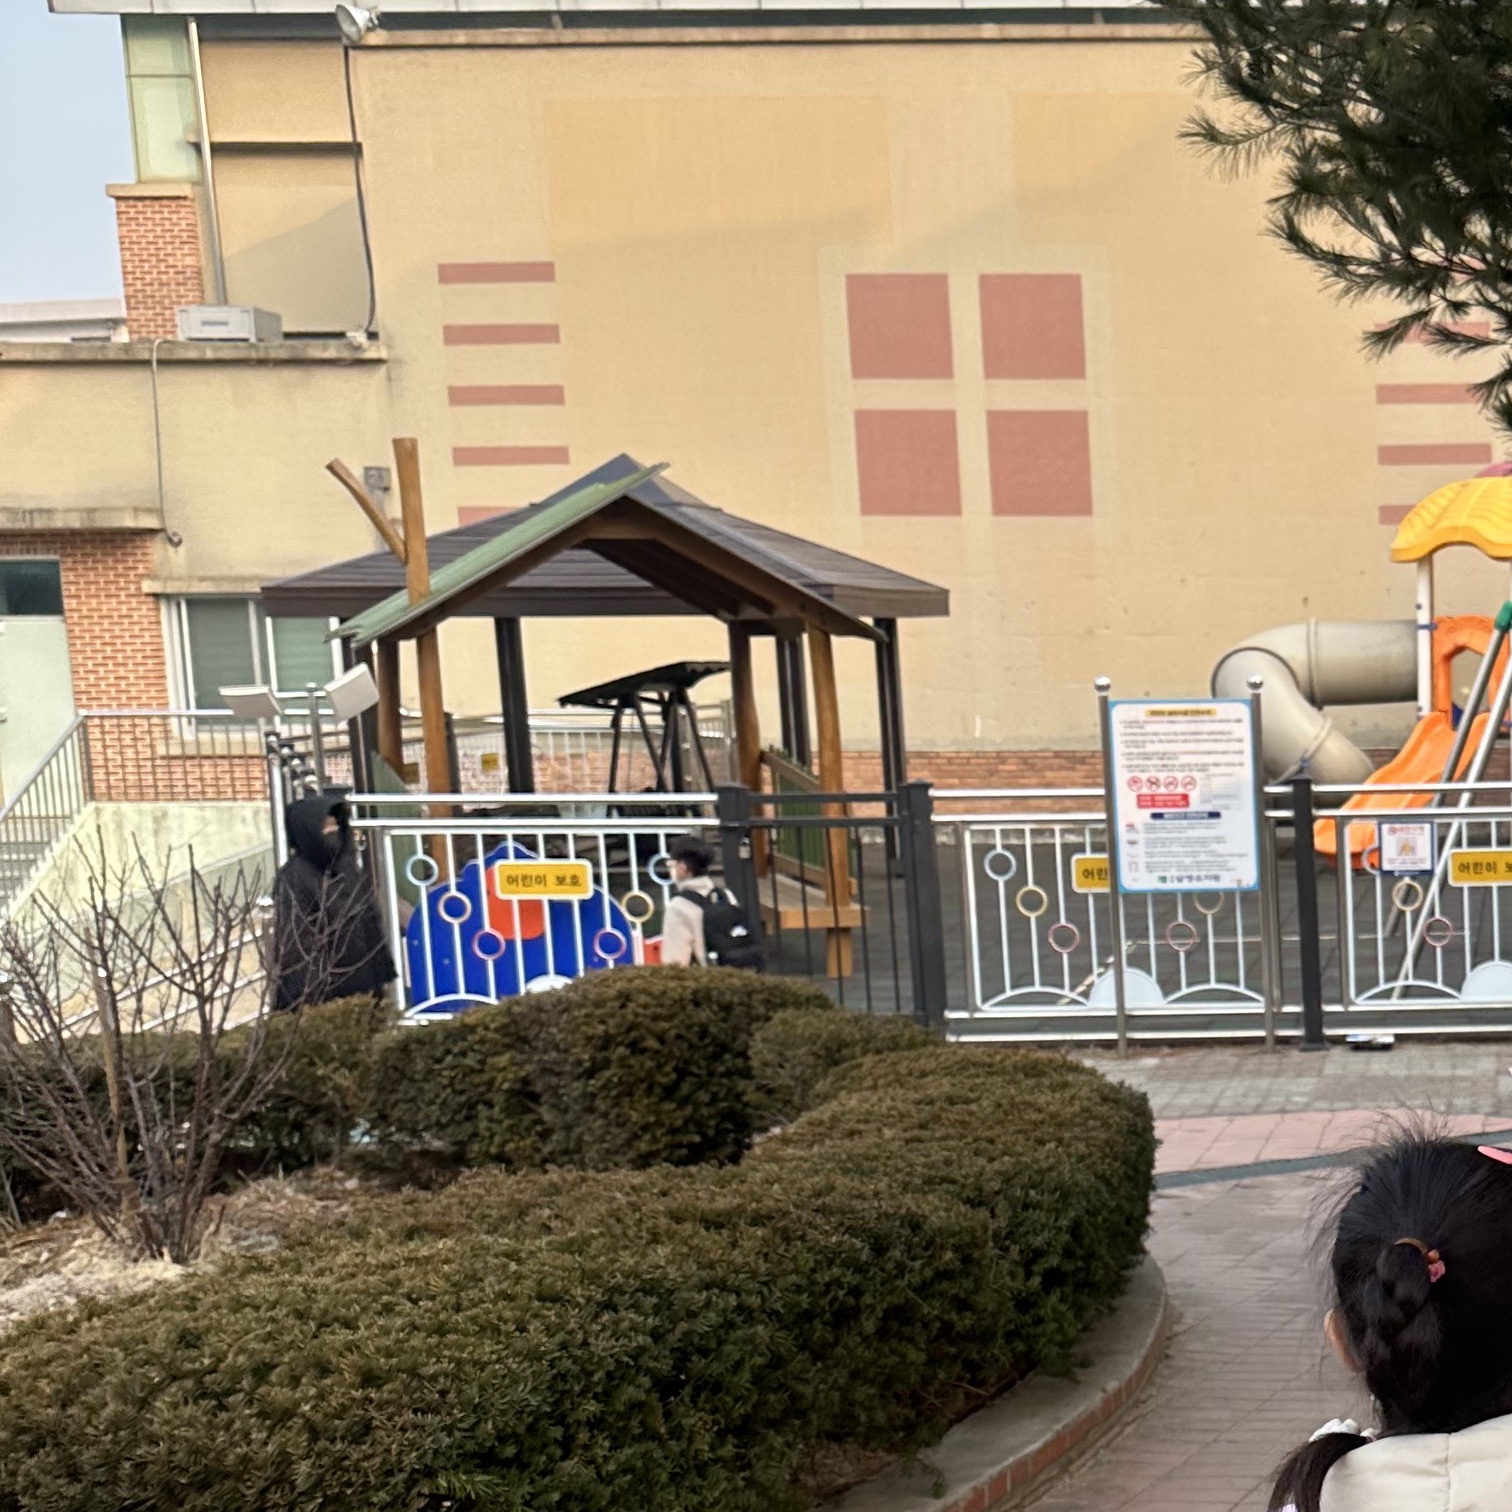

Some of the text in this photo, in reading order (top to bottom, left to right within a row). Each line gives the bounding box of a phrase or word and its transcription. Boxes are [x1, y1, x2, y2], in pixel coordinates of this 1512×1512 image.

[1082, 867, 1108, 882] 어린
[1458, 861, 1498, 875] 어린이
[506, 872, 582, 888] 어린이 보호
